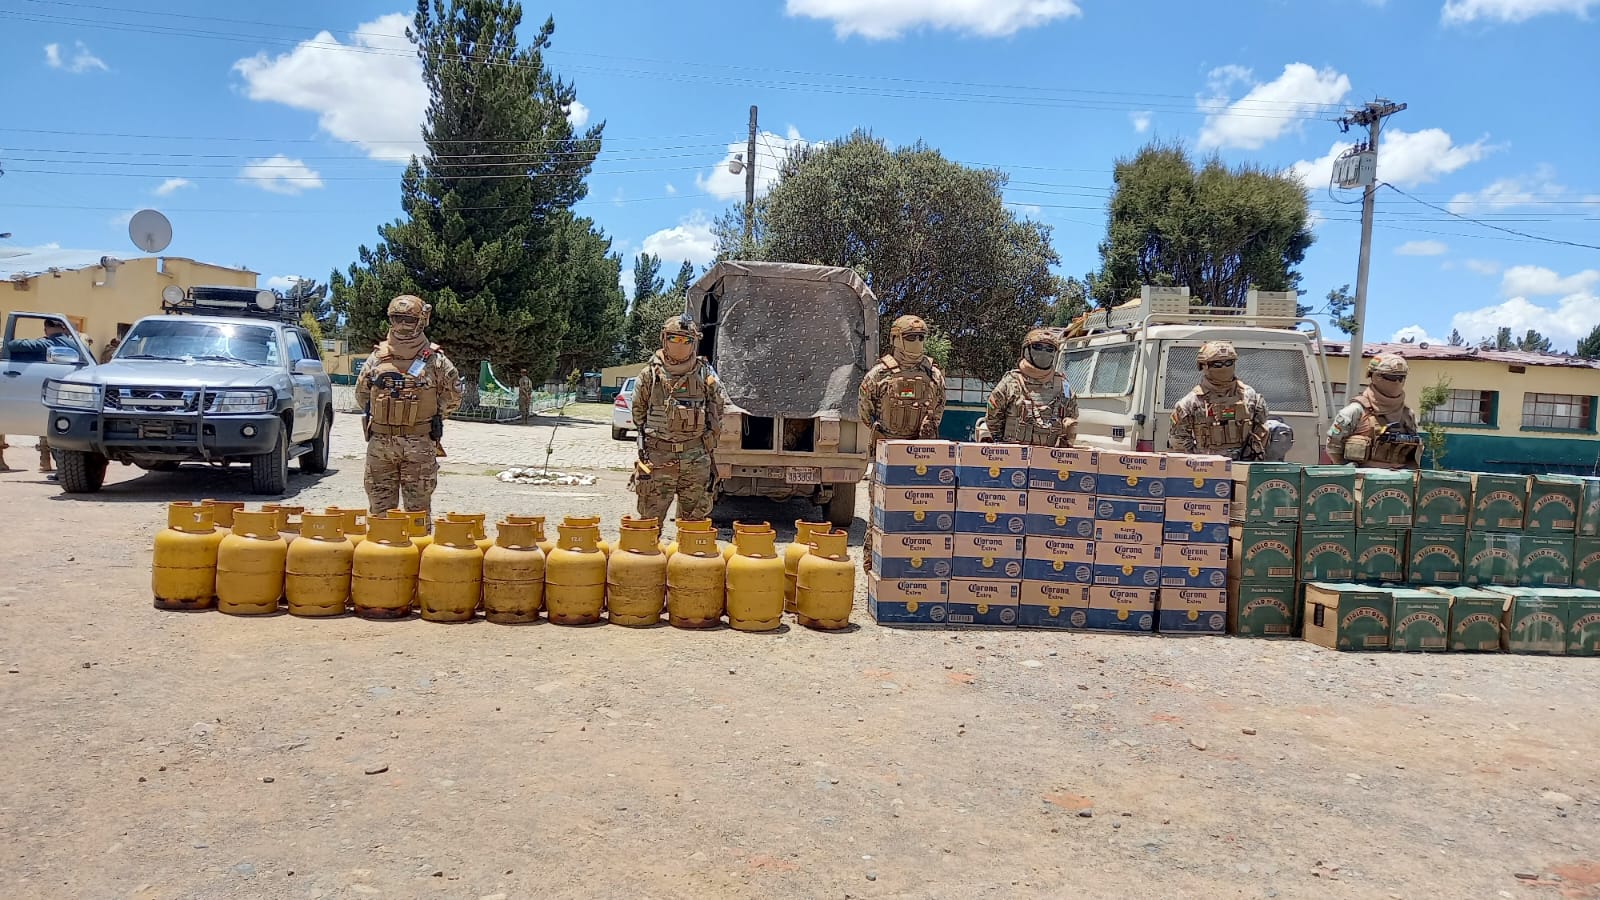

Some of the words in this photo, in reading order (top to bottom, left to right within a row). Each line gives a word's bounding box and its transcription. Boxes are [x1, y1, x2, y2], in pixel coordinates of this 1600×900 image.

[907, 445, 936, 454] Corona
[981, 447, 1009, 456] Corona
[1050, 450, 1079, 460] Corona
[1119, 456, 1148, 464] Corona
[1186, 459, 1214, 467] Corona
[905, 491, 934, 499] Corona
[977, 492, 1007, 501] Corona
[1047, 495, 1076, 504] Corona
[1184, 502, 1211, 510] Corona
[902, 537, 932, 546] Corona
[973, 537, 1002, 546] Corona
[1046, 540, 1074, 549] Corona
[1115, 546, 1142, 554] Corona
[1181, 547, 1208, 556] Corona
[898, 582, 928, 590] Corona
[968, 584, 998, 592] Corona
[1041, 585, 1070, 594] Corona
[1110, 590, 1138, 598] Corona
[1180, 590, 1208, 598] Corona
